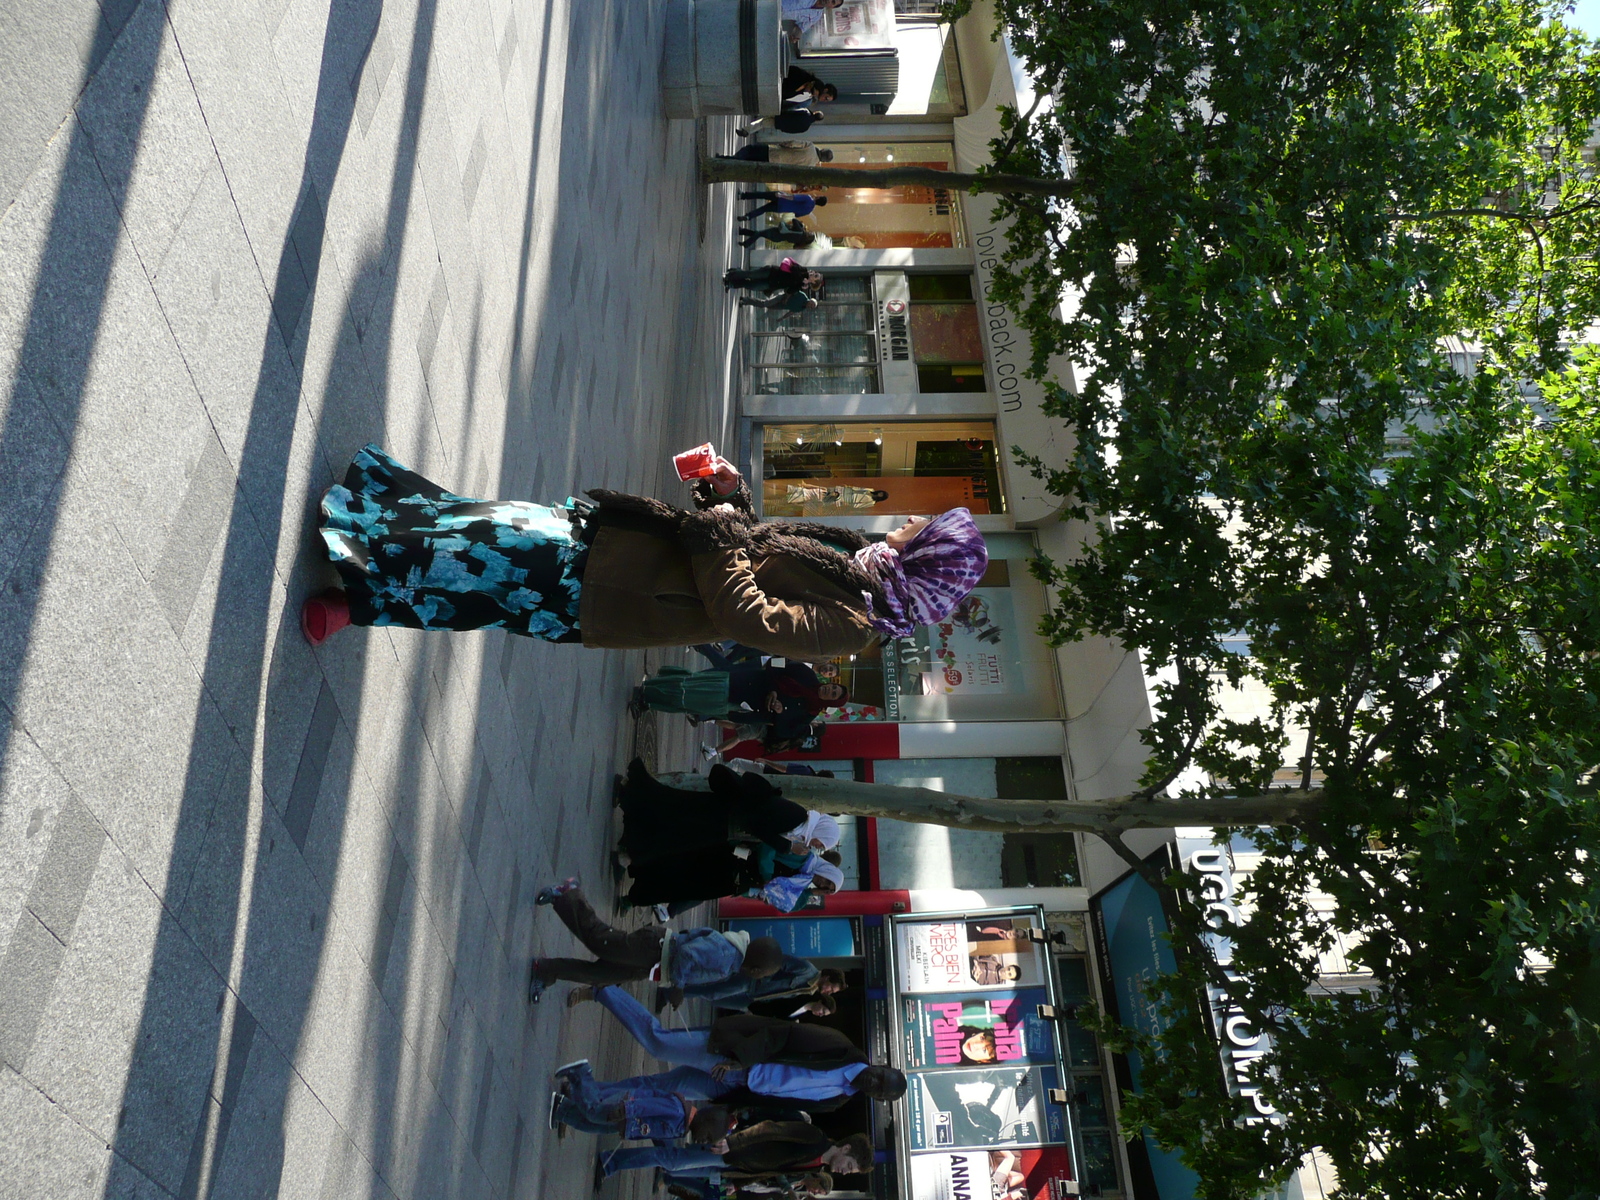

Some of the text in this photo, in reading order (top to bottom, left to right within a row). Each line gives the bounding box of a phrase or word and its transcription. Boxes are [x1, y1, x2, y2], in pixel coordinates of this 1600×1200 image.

[889, 316, 908, 361] MORGAN
[886, 662, 898, 717] SELECTION
[977, 653, 989, 686] FRUTTI
[988, 655, 999, 684] TUTTI
[1191, 850, 1236, 929] UGC
[929, 924, 945, 968] MERCI
[932, 1002, 965, 1064] Palm
[991, 1000, 1024, 1061] Irina
[950, 1155, 971, 1200] ANNA
